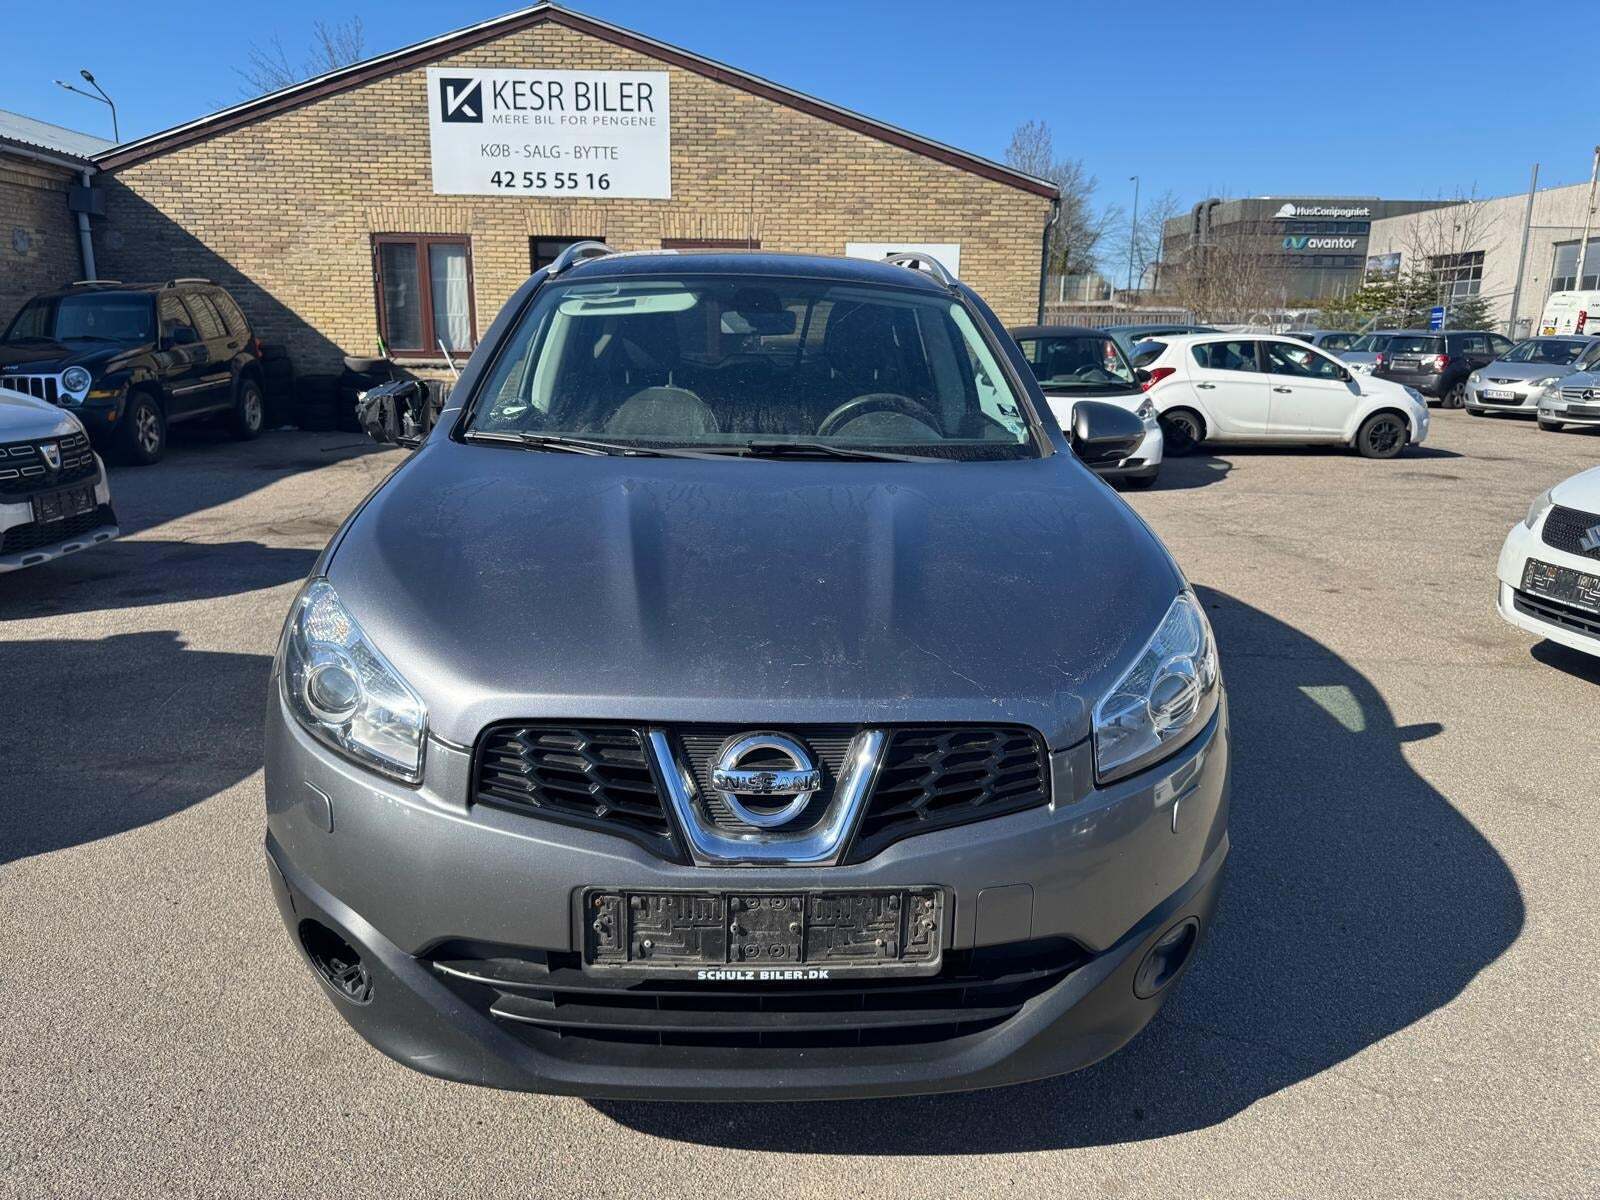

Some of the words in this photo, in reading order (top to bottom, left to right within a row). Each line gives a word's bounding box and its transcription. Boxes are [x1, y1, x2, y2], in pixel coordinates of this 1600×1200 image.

[493, 80, 564, 110] KESR
[575, 82, 654, 112] BILER
[492, 115, 529, 125] MERE
[534, 116, 555, 126] BIL
[561, 116, 587, 126] FOR
[593, 116, 657, 126] PENGENE
[481, 144, 510, 157] KØB
[524, 145, 560, 159] SALG
[574, 146, 618, 160] BYTTE
[491, 171, 515, 187] 42
[523, 172, 547, 188] 55
[554, 173, 578, 188] 55
[586, 173, 610, 190] 16
[1296, 206, 1370, 217] HusCompagniet
[1308, 237, 1357, 249] avantor
[697, 970, 754, 980] SCHULZ
[759, 970, 829, 980] BILER.DK
